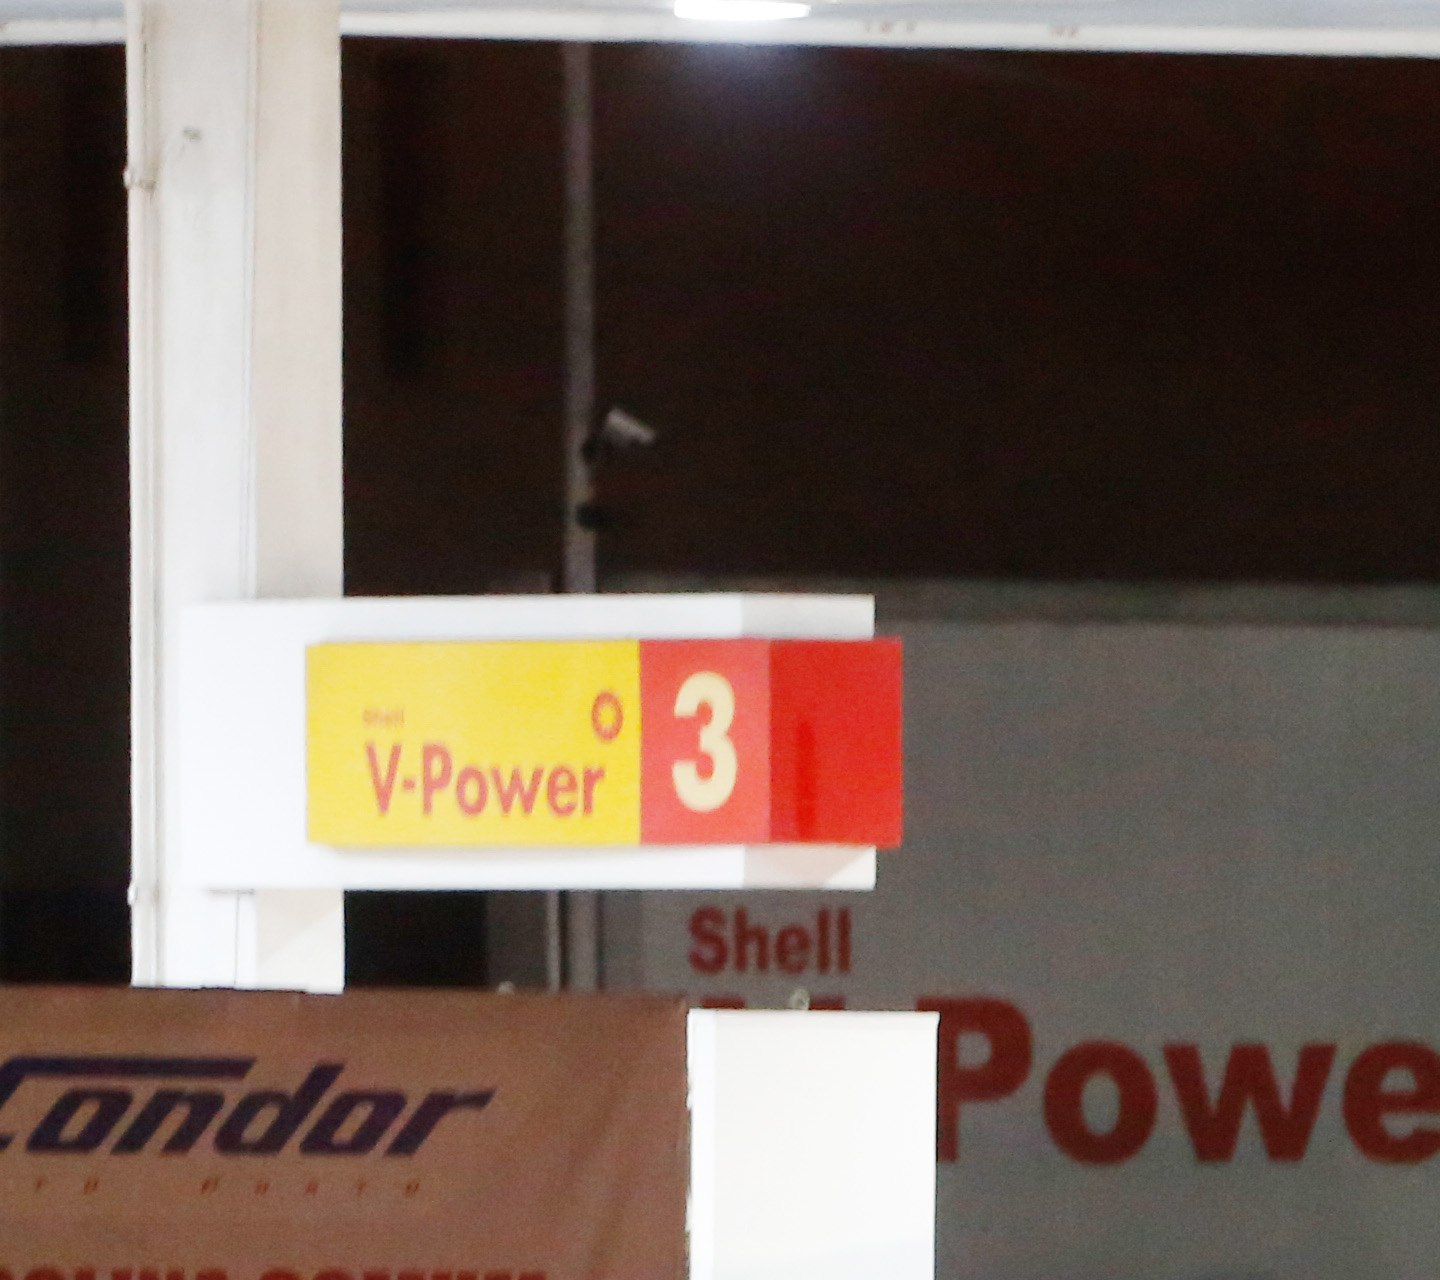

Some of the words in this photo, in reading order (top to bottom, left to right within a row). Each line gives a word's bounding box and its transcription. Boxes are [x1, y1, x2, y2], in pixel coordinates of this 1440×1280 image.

[672, 670, 738, 812] 3
[366, 742, 606, 817] V-Power
[687, 906, 853, 975] Shell
